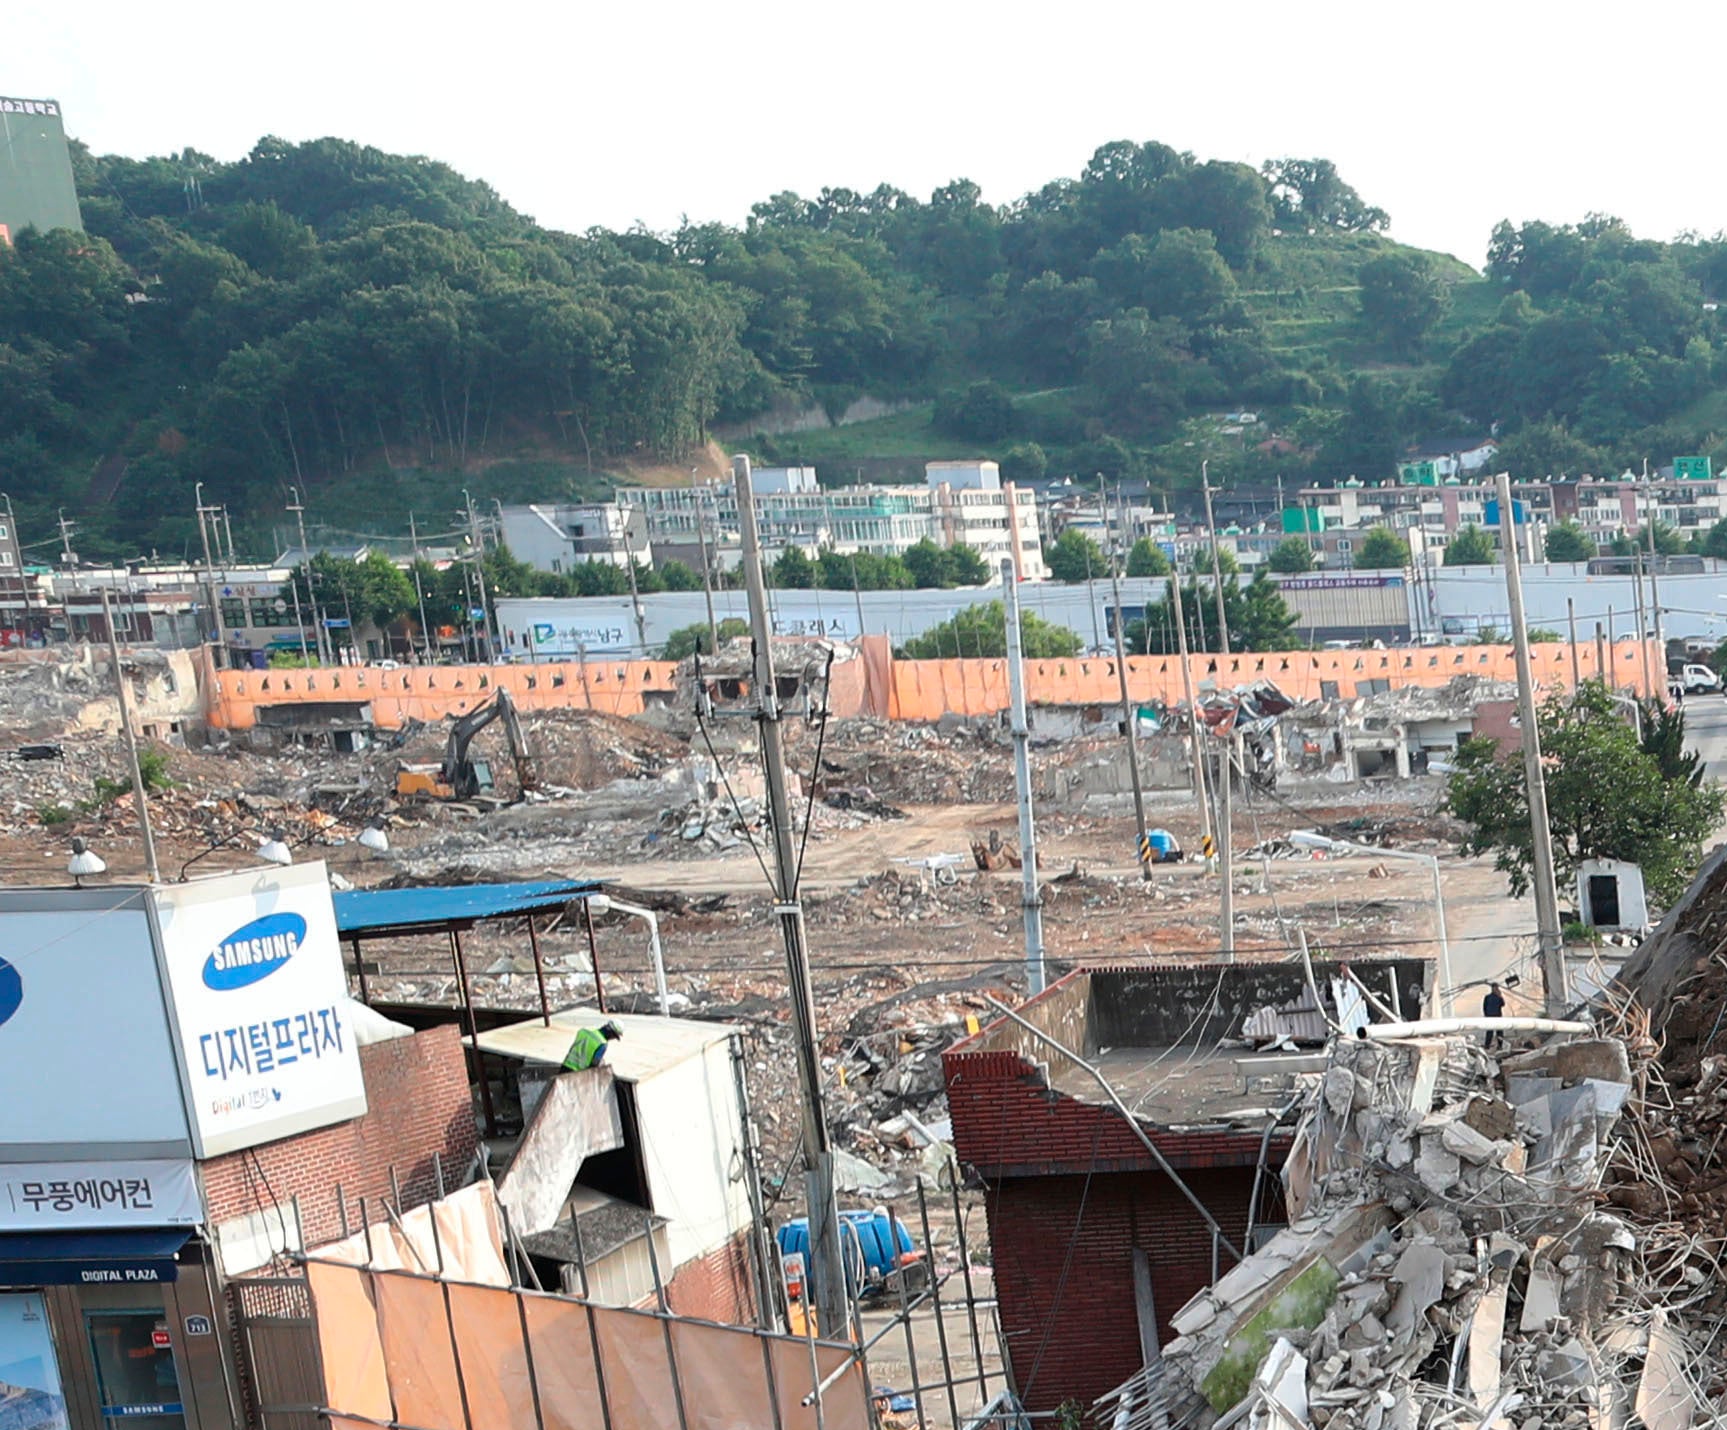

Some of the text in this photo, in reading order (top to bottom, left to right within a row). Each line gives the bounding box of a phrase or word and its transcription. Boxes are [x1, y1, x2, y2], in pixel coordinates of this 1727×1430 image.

[213, 931, 298, 971] SAMSUNG
[199, 1006, 343, 1081] 디지털프라자
[22, 1178, 154, 1212] 무풍에어컨
[81, 1269, 158, 1281] DIGITAL PLAZA
